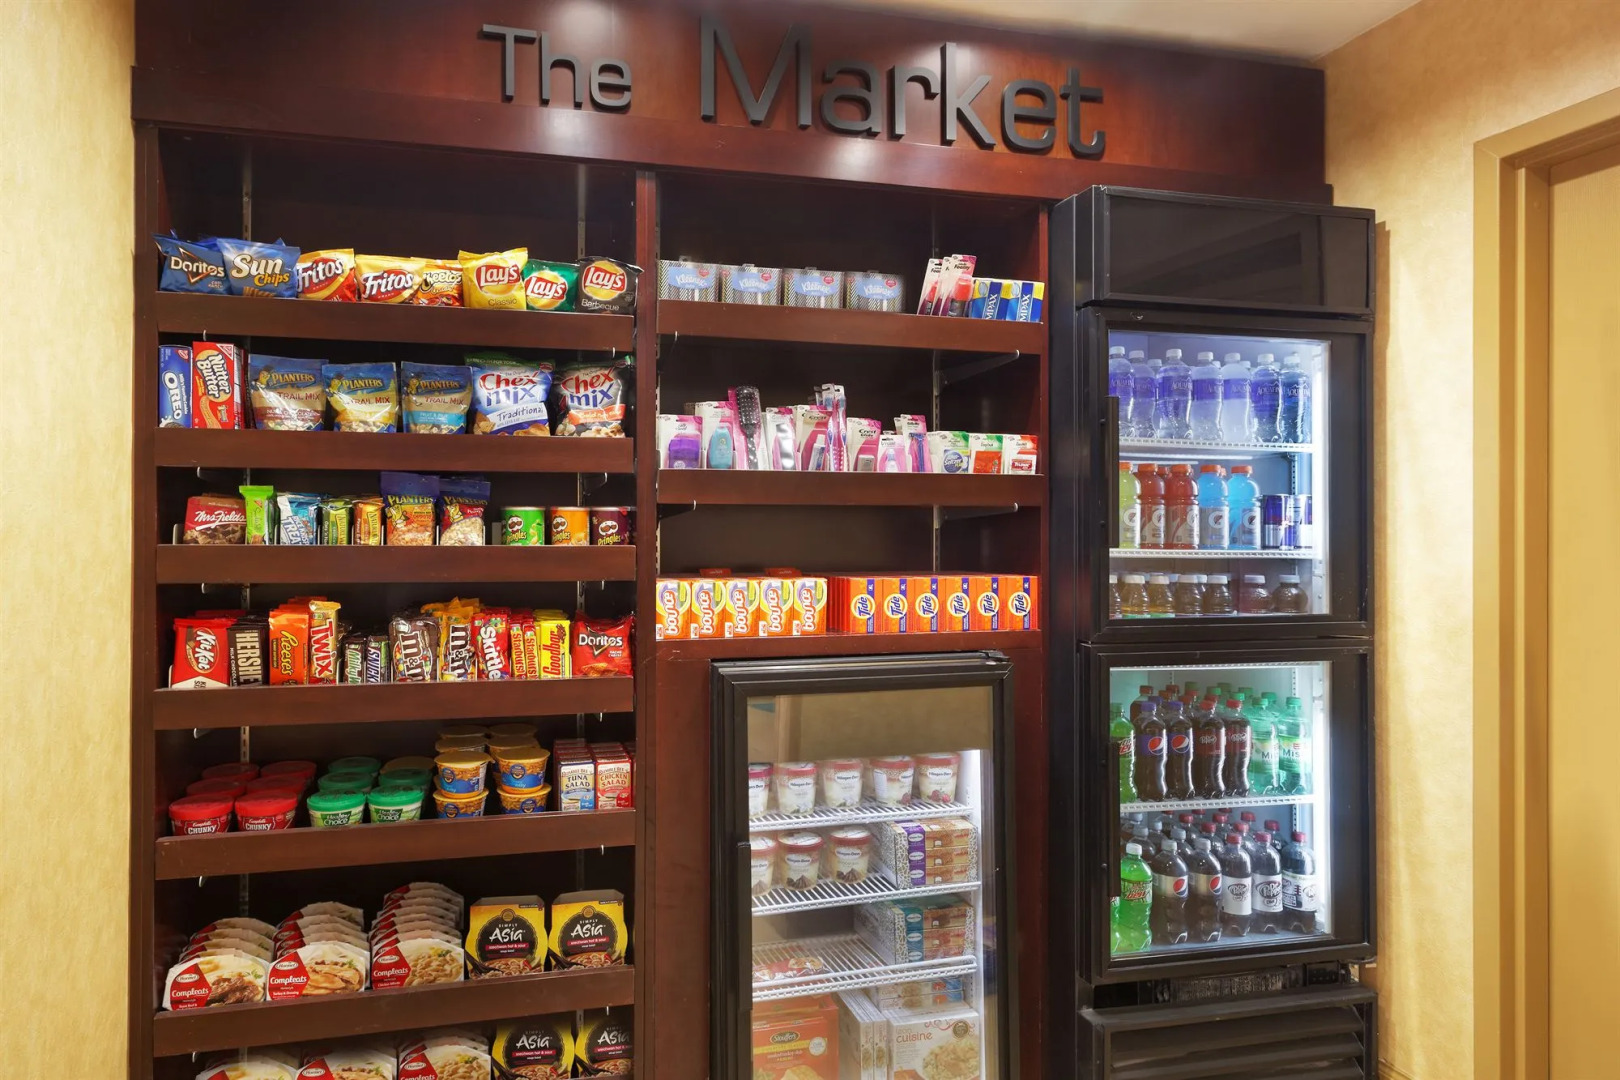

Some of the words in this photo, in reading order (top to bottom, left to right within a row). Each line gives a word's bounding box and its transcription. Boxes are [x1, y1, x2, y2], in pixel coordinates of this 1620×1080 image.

[482, 24, 632, 113] The
[699, 17, 1106, 157] Market
[170, 256, 225, 278] Doritos
[231, 253, 284, 279] Sun
[253, 271, 290, 287] Chips
[296, 259, 345, 293] Fritos
[676, 274, 707, 287] Kleenex
[360, 270, 415, 300] Fritos
[739, 279, 770, 291] Kleenex
[801, 281, 831, 294] Kleenex
[864, 284, 896, 297] Kleenex
[487, 298, 518, 307] Classic
[581, 298, 620, 311] Barbecue
[195, 359, 221, 399] Butter
[207, 353, 231, 395] Nutter
[271, 372, 316, 385] PLANTERS
[480, 370, 540, 391] Chex
[560, 366, 615, 394] Chex
[342, 379, 383, 391] PLANTERS
[420, 380, 460, 392] PLANTERS
[163, 371, 183, 420] OREO
[277, 391, 304, 400] TRAIL
[305, 392, 322, 401] MIX
[375, 396, 391, 404] MIX
[424, 396, 448, 404] TRAIL
[449, 396, 465, 405] MIX
[569, 381, 615, 408] mix
[496, 406, 544, 423] Traditional
[387, 494, 435, 507] PLANTERS
[443, 495, 488, 507] PLANTERS
[194, 510, 216, 523] Mrs
[213, 510, 247, 529] Fields
[507, 530, 528, 543] Pringles
[552, 530, 571, 542] Pringles
[598, 534, 622, 546] Pringles
[858, 596, 871, 617] Tide
[890, 596, 904, 616] Tide
[922, 595, 935, 616] Tide
[953, 595, 966, 615] Tide
[983, 594, 996, 614] Tide
[1015, 594, 1027, 614] Tide
[579, 633, 623, 647] Doritos
[280, 630, 299, 676] Reese's
[310, 618, 335, 679] TWIX
[512, 632, 526, 674] Starburst
[542, 630, 561, 676] Goodbar
[236, 632, 262, 684] HERSHE
[568, 774, 588, 782] TUNA
[600, 773, 628, 782] CHICKEN
[602, 779, 627, 787] SALAD
[565, 781, 590, 789] SALAD
[245, 823, 272, 832] CHUNKY
[323, 817, 349, 826] Choice
[187, 825, 217, 835] CHUNKY
[488, 927, 524, 943] Asia
[570, 923, 604, 938] Asia
[373, 967, 409, 978] Compleats
[270, 975, 307, 986] Compleats
[171, 987, 210, 998] Compleats
[516, 1034, 550, 1052] Asia
[597, 1030, 630, 1048] Asia
[896, 1032, 933, 1044] cuisine
